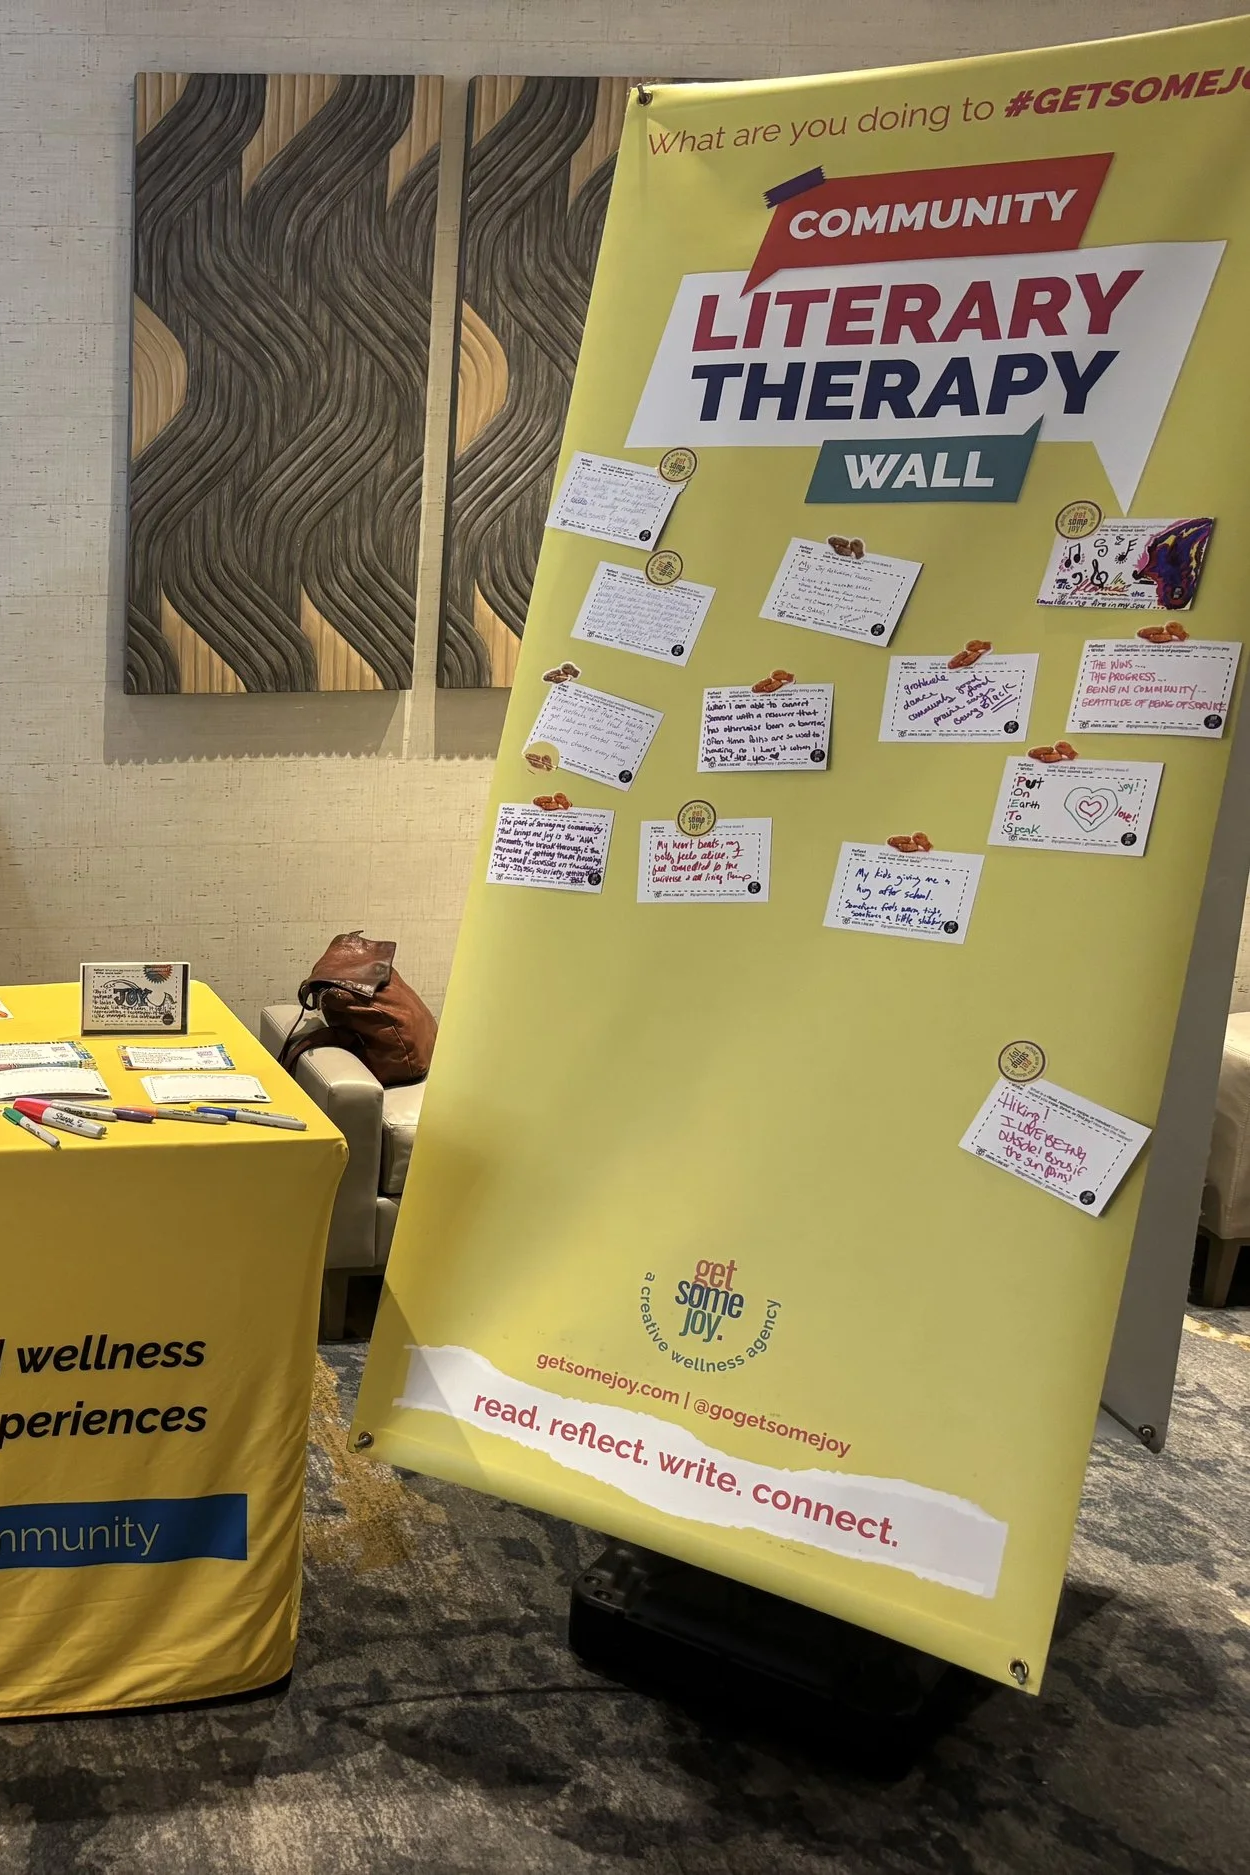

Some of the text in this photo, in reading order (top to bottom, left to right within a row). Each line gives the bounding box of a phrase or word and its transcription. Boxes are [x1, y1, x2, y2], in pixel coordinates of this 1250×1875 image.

[648, 66, 1250, 155] What are you doing to #GETSOMEJ
[788, 189, 1078, 240] COMMUNITY
[691, 269, 1145, 352] LITERARY
[691, 350, 1120, 422] THERAPY
[844, 452, 995, 490] WALL
[1090, 660, 1106, 669] THE
[1082, 698, 1132, 708] GRATITUDE
[1086, 685, 1116, 694] BEING
[1118, 685, 1129, 693] IN
[1010, 799, 1040, 809] Earth
[1014, 788, 1030, 798] On
[1008, 810, 1022, 820] To
[855, 868, 869, 882] My
[875, 867, 892, 879] kids
[896, 874, 921, 888] giving
[856, 884, 872, 900] hug
[878, 885, 901, 896] after
[692, 1259, 737, 1291] get
[675, 1280, 744, 1319] some
[640, 1271, 782, 1373] a creative wellness agency
[678, 1308, 723, 1343] joy.
[16, 1334, 206, 1374] wellness
[536, 1353, 852, 1458] getsomejoy.com @gogetsomejoy
[473, 1393, 898, 1548] read. reflect. write. connect.
